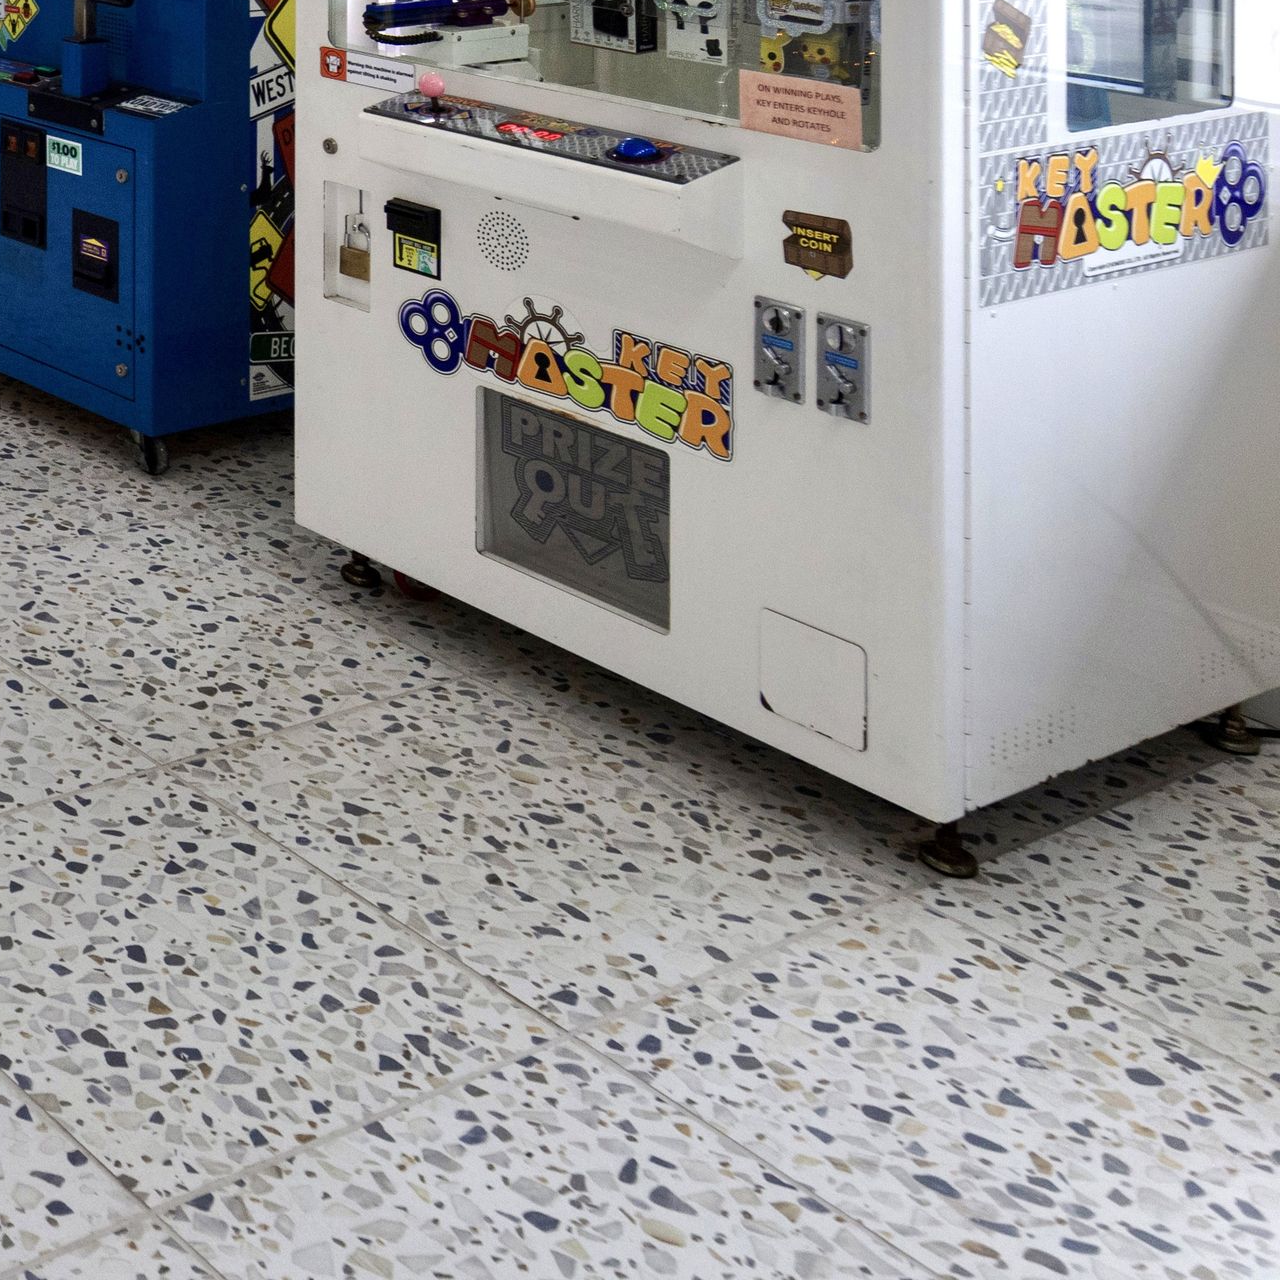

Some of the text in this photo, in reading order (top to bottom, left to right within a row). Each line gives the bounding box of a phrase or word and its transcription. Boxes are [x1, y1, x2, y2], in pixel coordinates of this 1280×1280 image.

[347, 60, 364, 69] Warning
[396, 70, 414, 79] alarmed
[251, 70, 296, 108] WEST
[380, 75, 397, 84] shaking
[757, 83, 771, 93] ON
[773, 85, 813, 99] WINNING
[756, 98, 847, 120] KEY ENTERS KEYHOLE
[771, 116, 832, 133] AND ROTATES
[51, 141, 77, 158] $1.00
[50, 154, 78, 170] TO PLAY
[1017, 148, 1098, 202] KEY
[1013, 170, 1215, 268] MASTER
[792, 225, 840, 244] INSERT
[799, 237, 833, 253] COIN
[619, 333, 732, 400] KEY
[465, 318, 732, 459] MASTER
[510, 405, 666, 498] PRIZE
